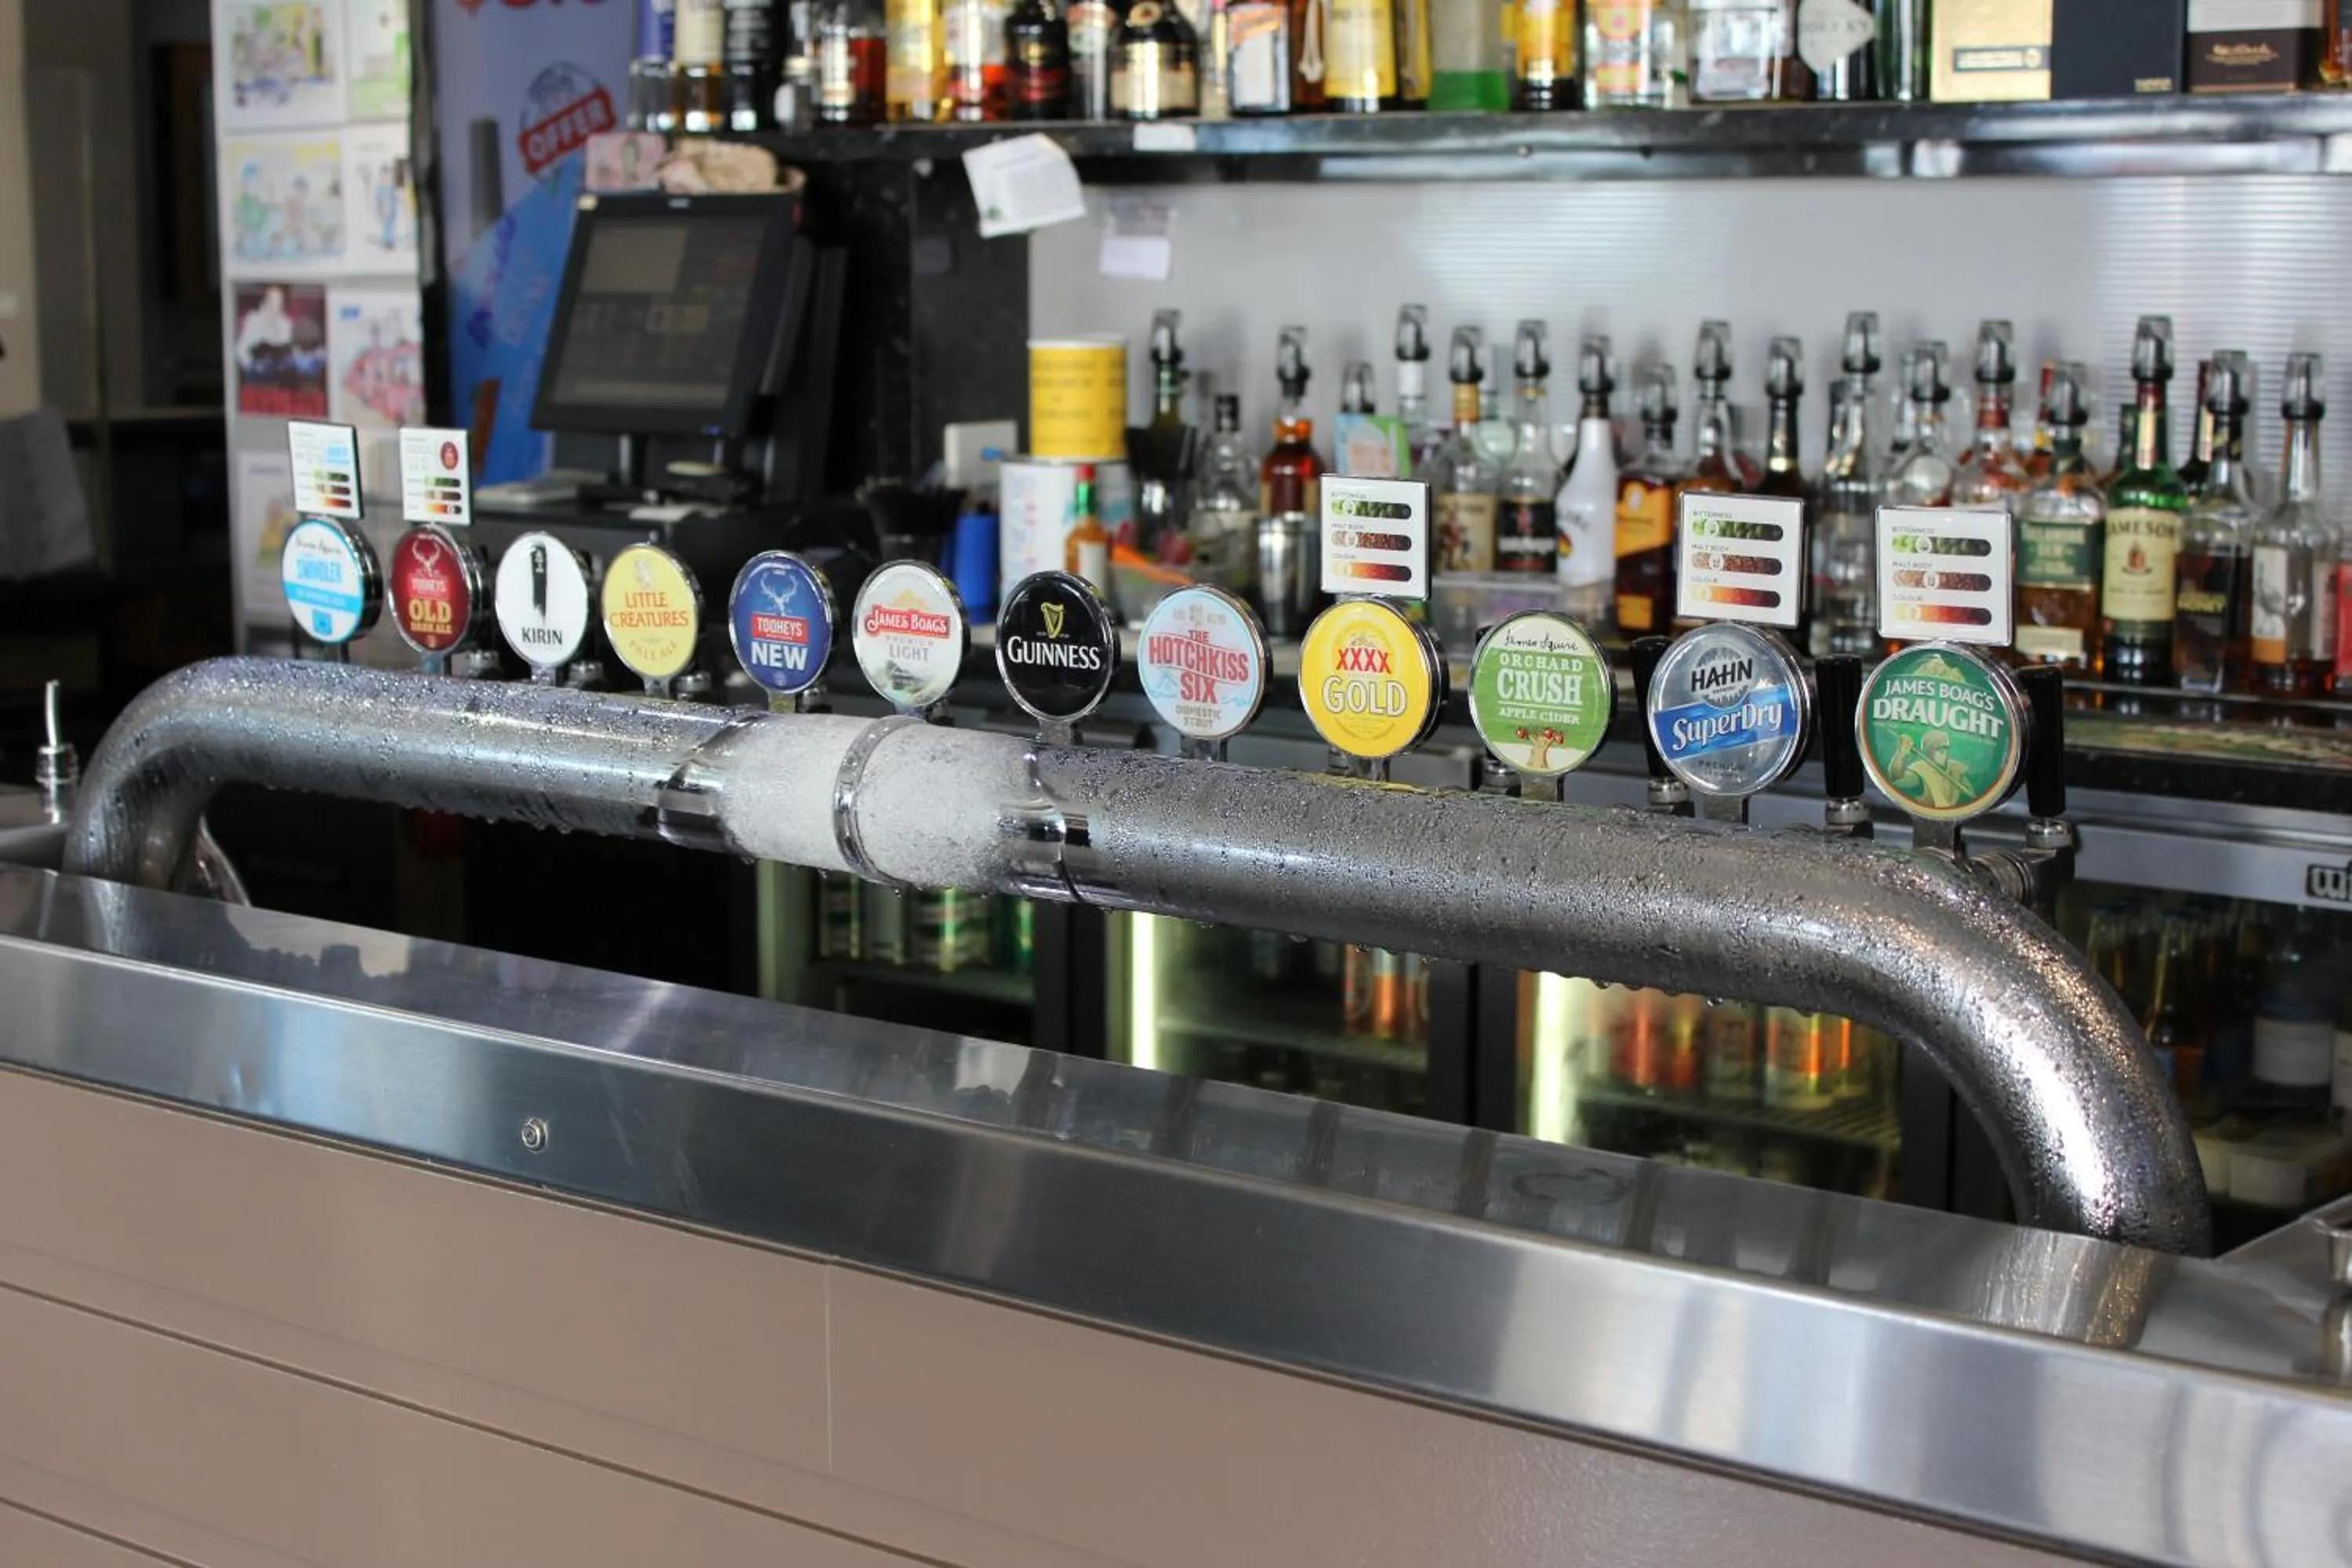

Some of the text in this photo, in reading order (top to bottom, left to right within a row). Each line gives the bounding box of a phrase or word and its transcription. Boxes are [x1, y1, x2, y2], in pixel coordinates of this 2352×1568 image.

[527, 99, 605, 162] OFFER
[408, 598, 452, 623] OLD
[625, 590, 668, 608] LITTLE
[609, 610, 689, 628] CREATURES
[756, 616, 803, 637] TOOHEYS
[866, 608, 909, 632] JAMES
[521, 627, 563, 645] KIRIN
[1187, 630, 1211, 643] THE
[1540, 632, 1579, 652] Squire
[628, 639, 678, 661] PALE ALE
[750, 641, 808, 671] NEW
[889, 644, 929, 663] LIGHT
[1007, 635, 1101, 670] GUINNESS
[1148, 636, 1250, 683] HOTCHKISS
[1336, 647, 1392, 675] XXXX
[1499, 652, 1583, 673] ORCHARD
[1690, 658, 1753, 691] HAHN
[1180, 672, 1218, 704] SIX
[1322, 674, 1408, 717] GOLD
[1497, 667, 1583, 706] CRUSH
[1882, 680, 1995, 711] JAMES BOAG'S
[1175, 704, 1222, 720] DOMESTIC
[1499, 706, 1581, 725] APPLE CIDER
[1873, 697, 2005, 739] DRAUGHT
